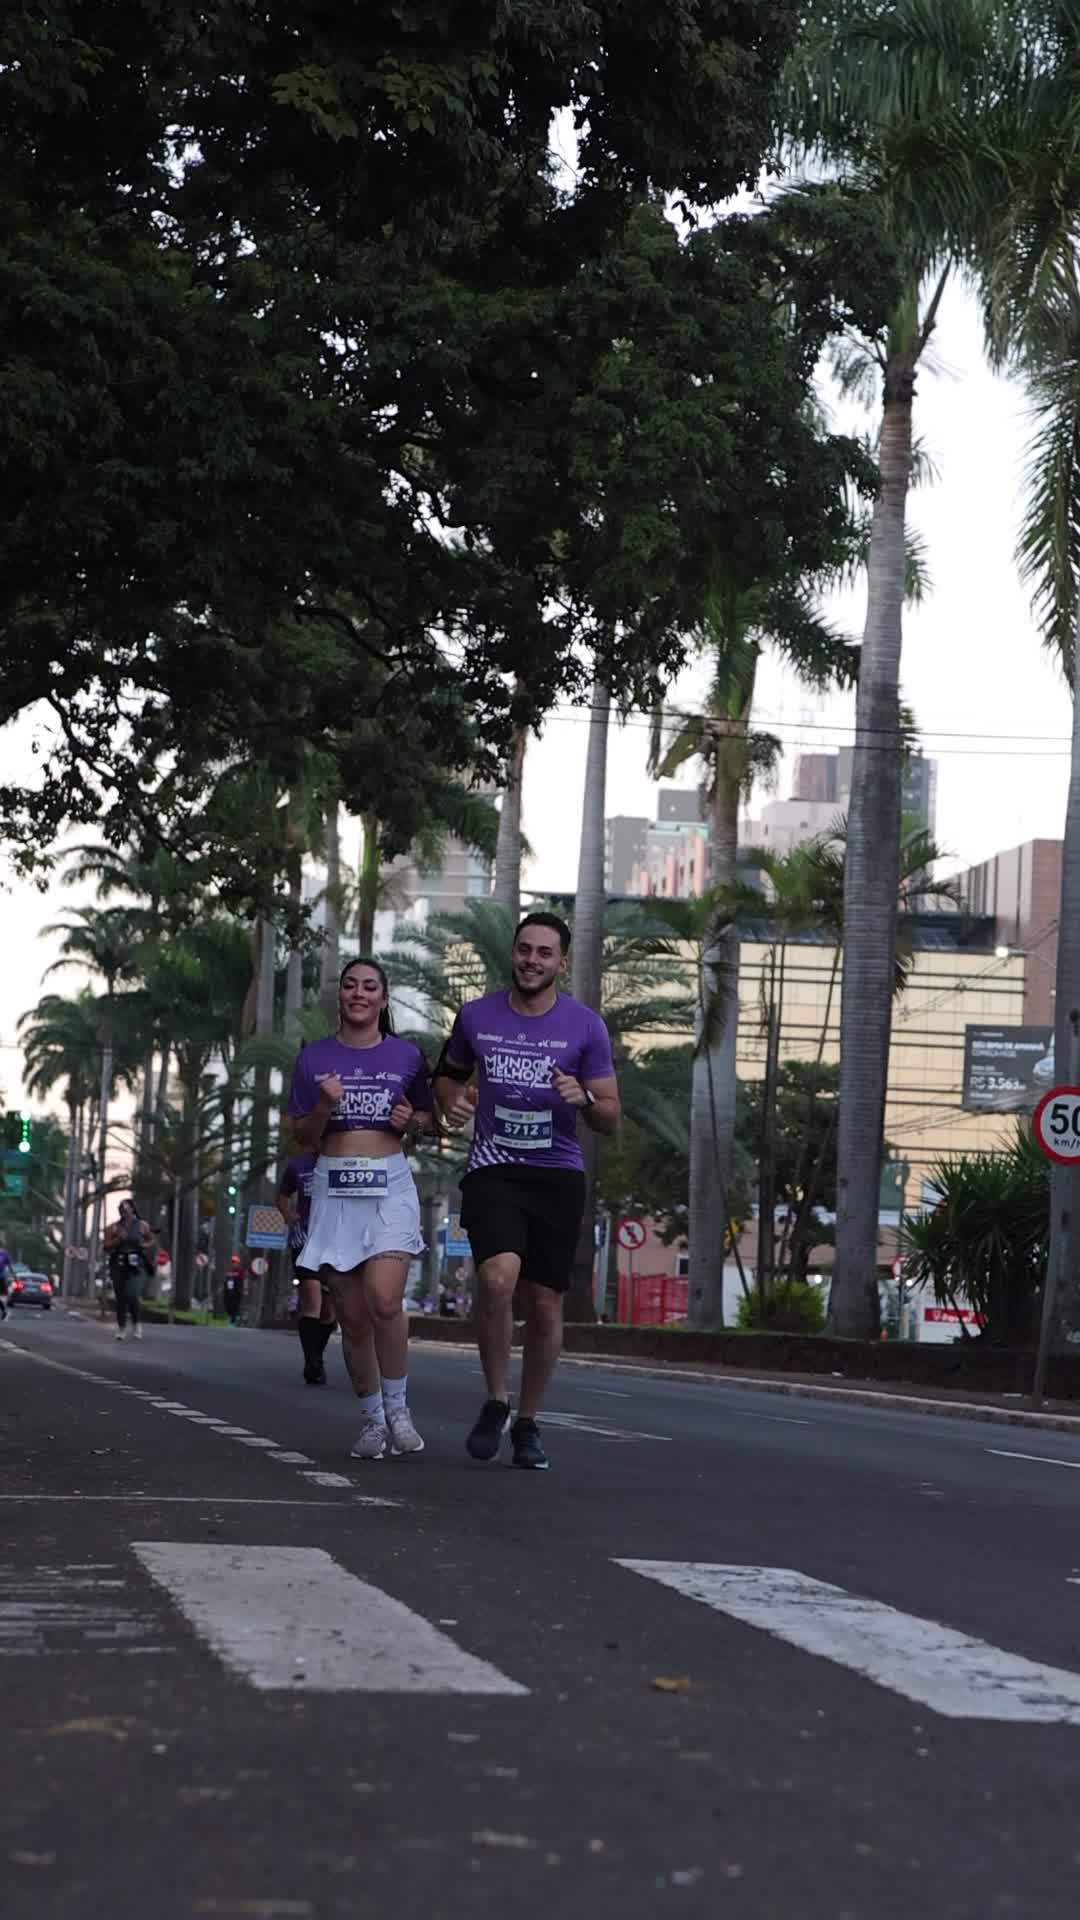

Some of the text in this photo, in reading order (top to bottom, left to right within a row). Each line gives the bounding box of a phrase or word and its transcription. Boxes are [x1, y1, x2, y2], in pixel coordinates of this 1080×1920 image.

[484, 1054, 547, 1072] MUNDO
[339, 1091, 385, 1104] UNDO
[337, 1103, 385, 1115] ELHOR
[504, 1122, 539, 1136] 5712
[339, 1171, 374, 1183] 6399
